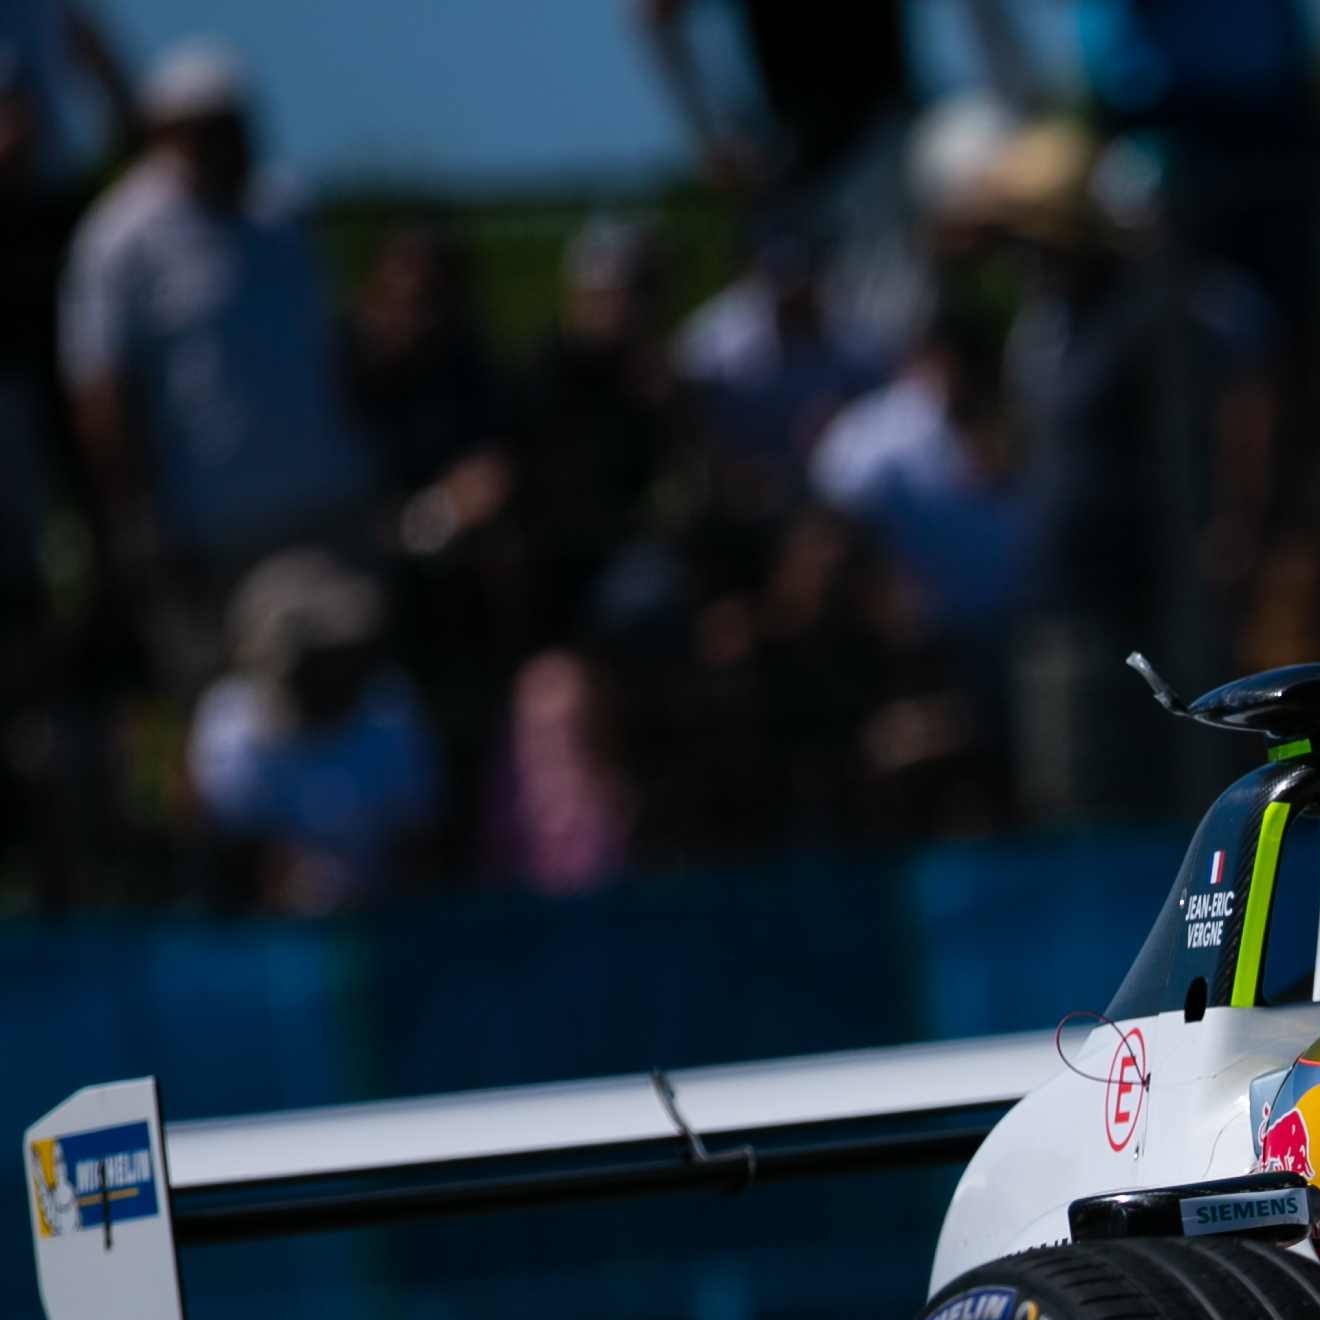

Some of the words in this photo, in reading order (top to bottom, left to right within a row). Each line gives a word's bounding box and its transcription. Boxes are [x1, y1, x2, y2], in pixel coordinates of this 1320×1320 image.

[1185, 890, 1236, 922] JEAN-ERIC
[1187, 920, 1225, 949] VERGNE
[1195, 1197, 1299, 1226] SIEMENS
